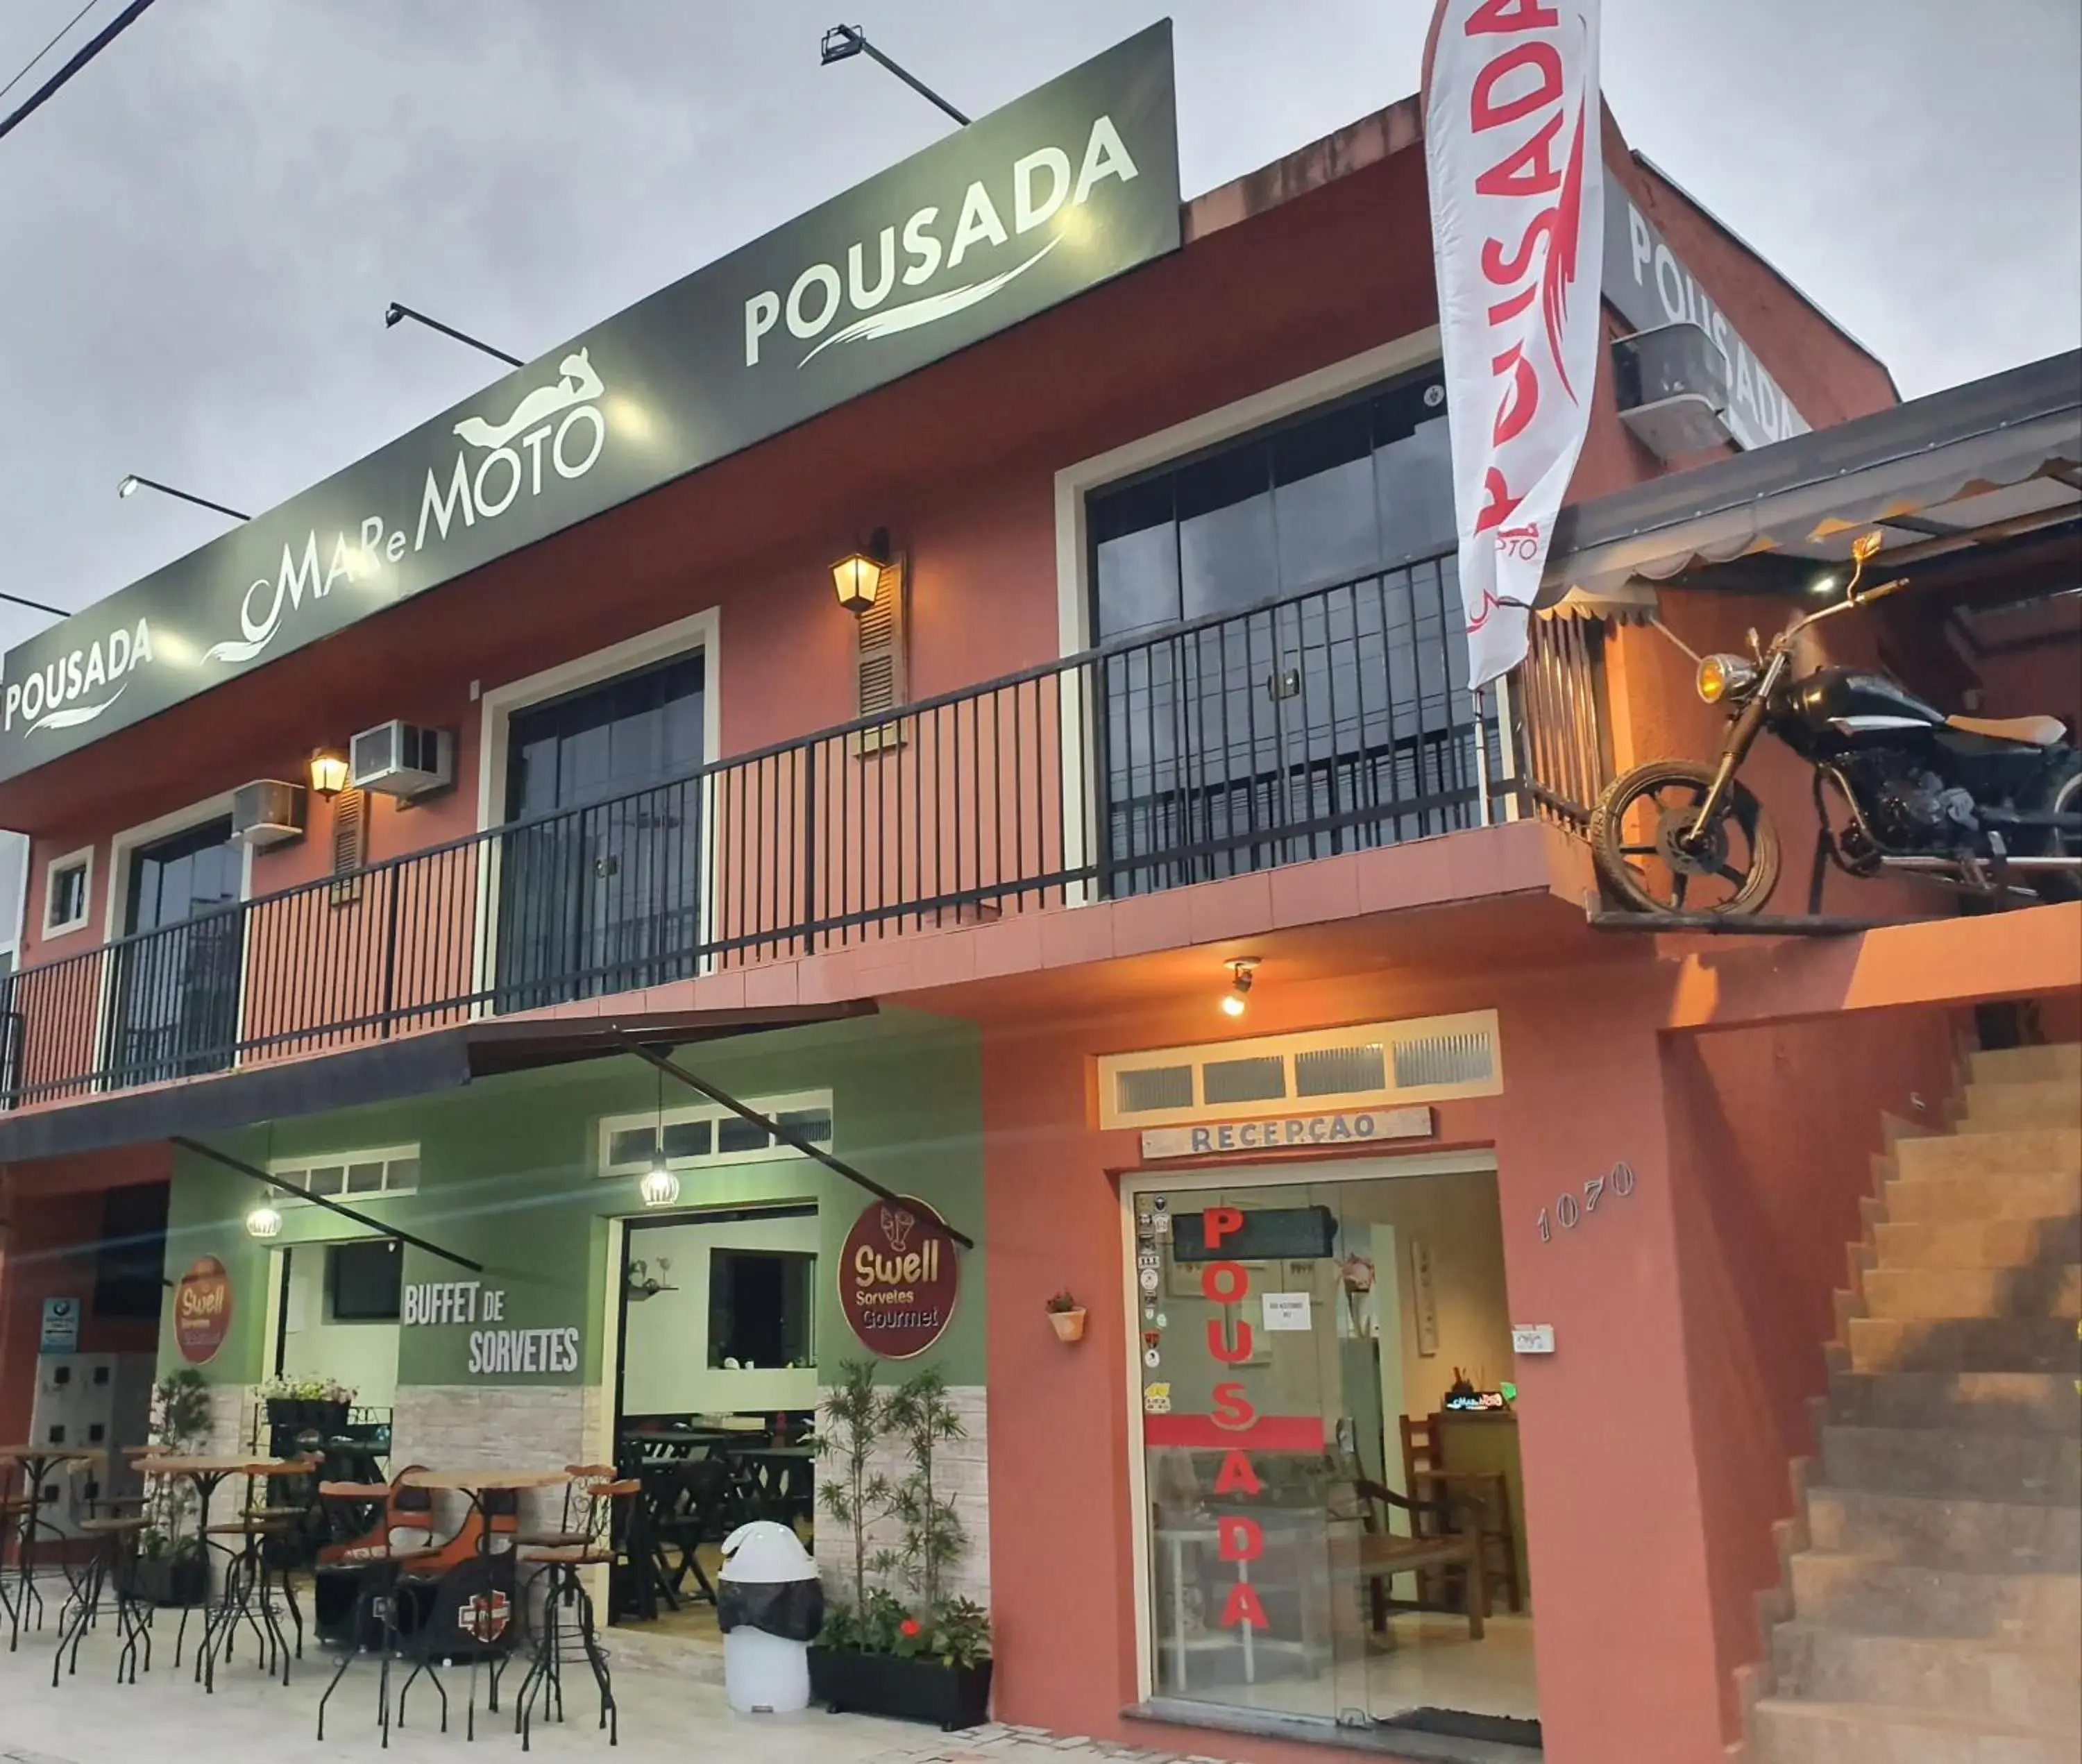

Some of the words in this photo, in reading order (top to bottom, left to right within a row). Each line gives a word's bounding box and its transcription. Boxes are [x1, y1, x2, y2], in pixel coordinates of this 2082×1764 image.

[745, 115, 1139, 367] POUSADA
[414, 405, 605, 552] MOTO
[4, 616, 153, 731] POUSADA
[1537, 1160, 1634, 1242] 1070
[854, 1238, 939, 1287] Swell
[181, 1284, 225, 1316] Swell
[404, 1281, 480, 1325] BUFFET
[482, 1290, 505, 1322] DE
[855, 1289, 915, 1306] Sorvetes
[863, 1307, 939, 1330] Gourmet
[468, 1326, 579, 1374] SORVETES
[1201, 1206, 1271, 1629] POUSADA
